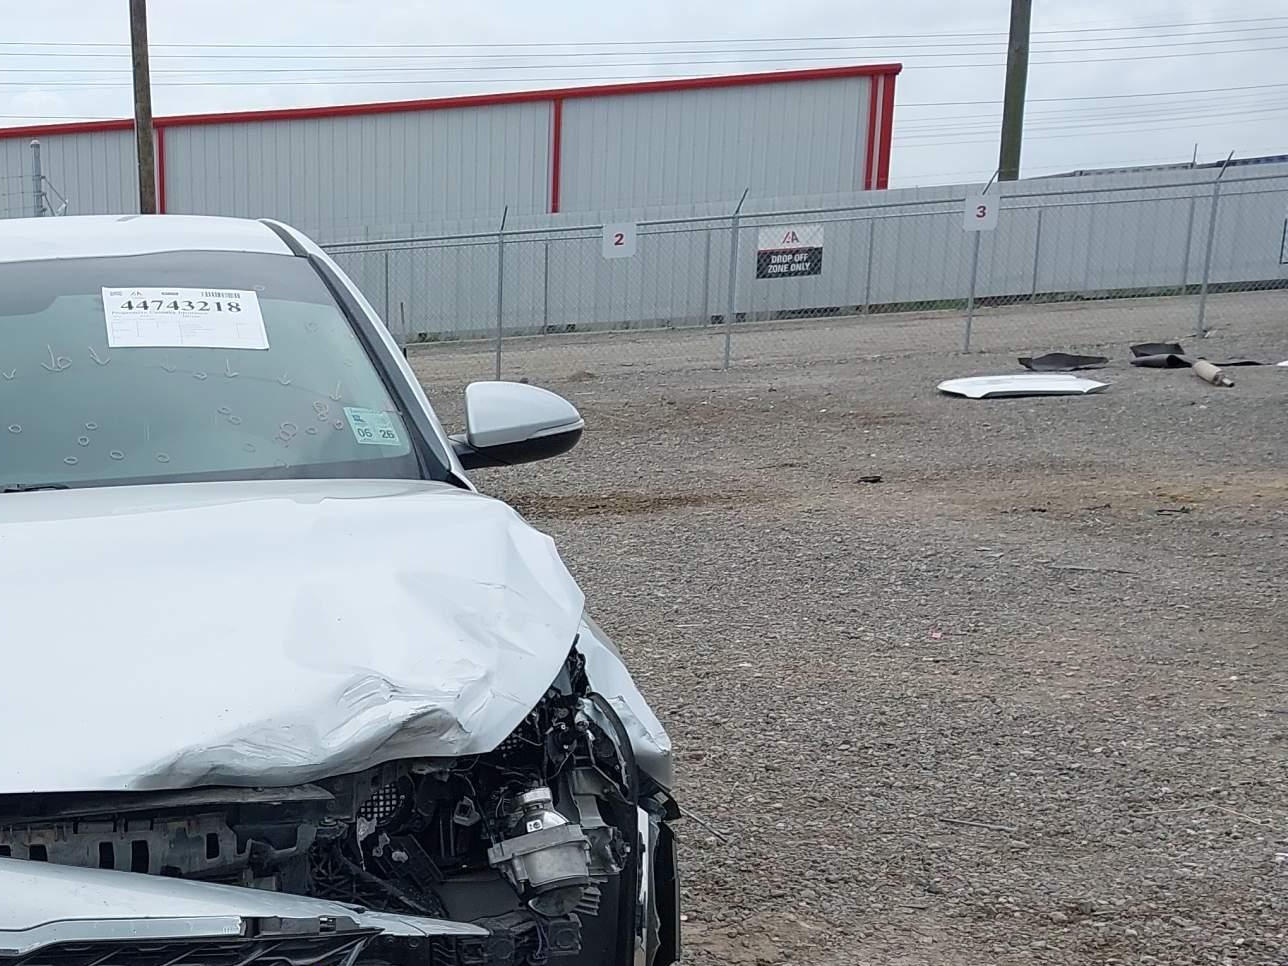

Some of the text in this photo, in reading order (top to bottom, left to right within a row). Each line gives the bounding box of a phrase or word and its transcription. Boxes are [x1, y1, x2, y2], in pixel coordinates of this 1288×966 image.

[976, 205, 986, 218] 3
[614, 233, 624, 246] 2
[772, 253, 808, 264] DROP OFF
[768, 262, 811, 273] ZONE ONLY
[120, 300, 241, 312] 44743218
[357, 428, 372, 438] 06
